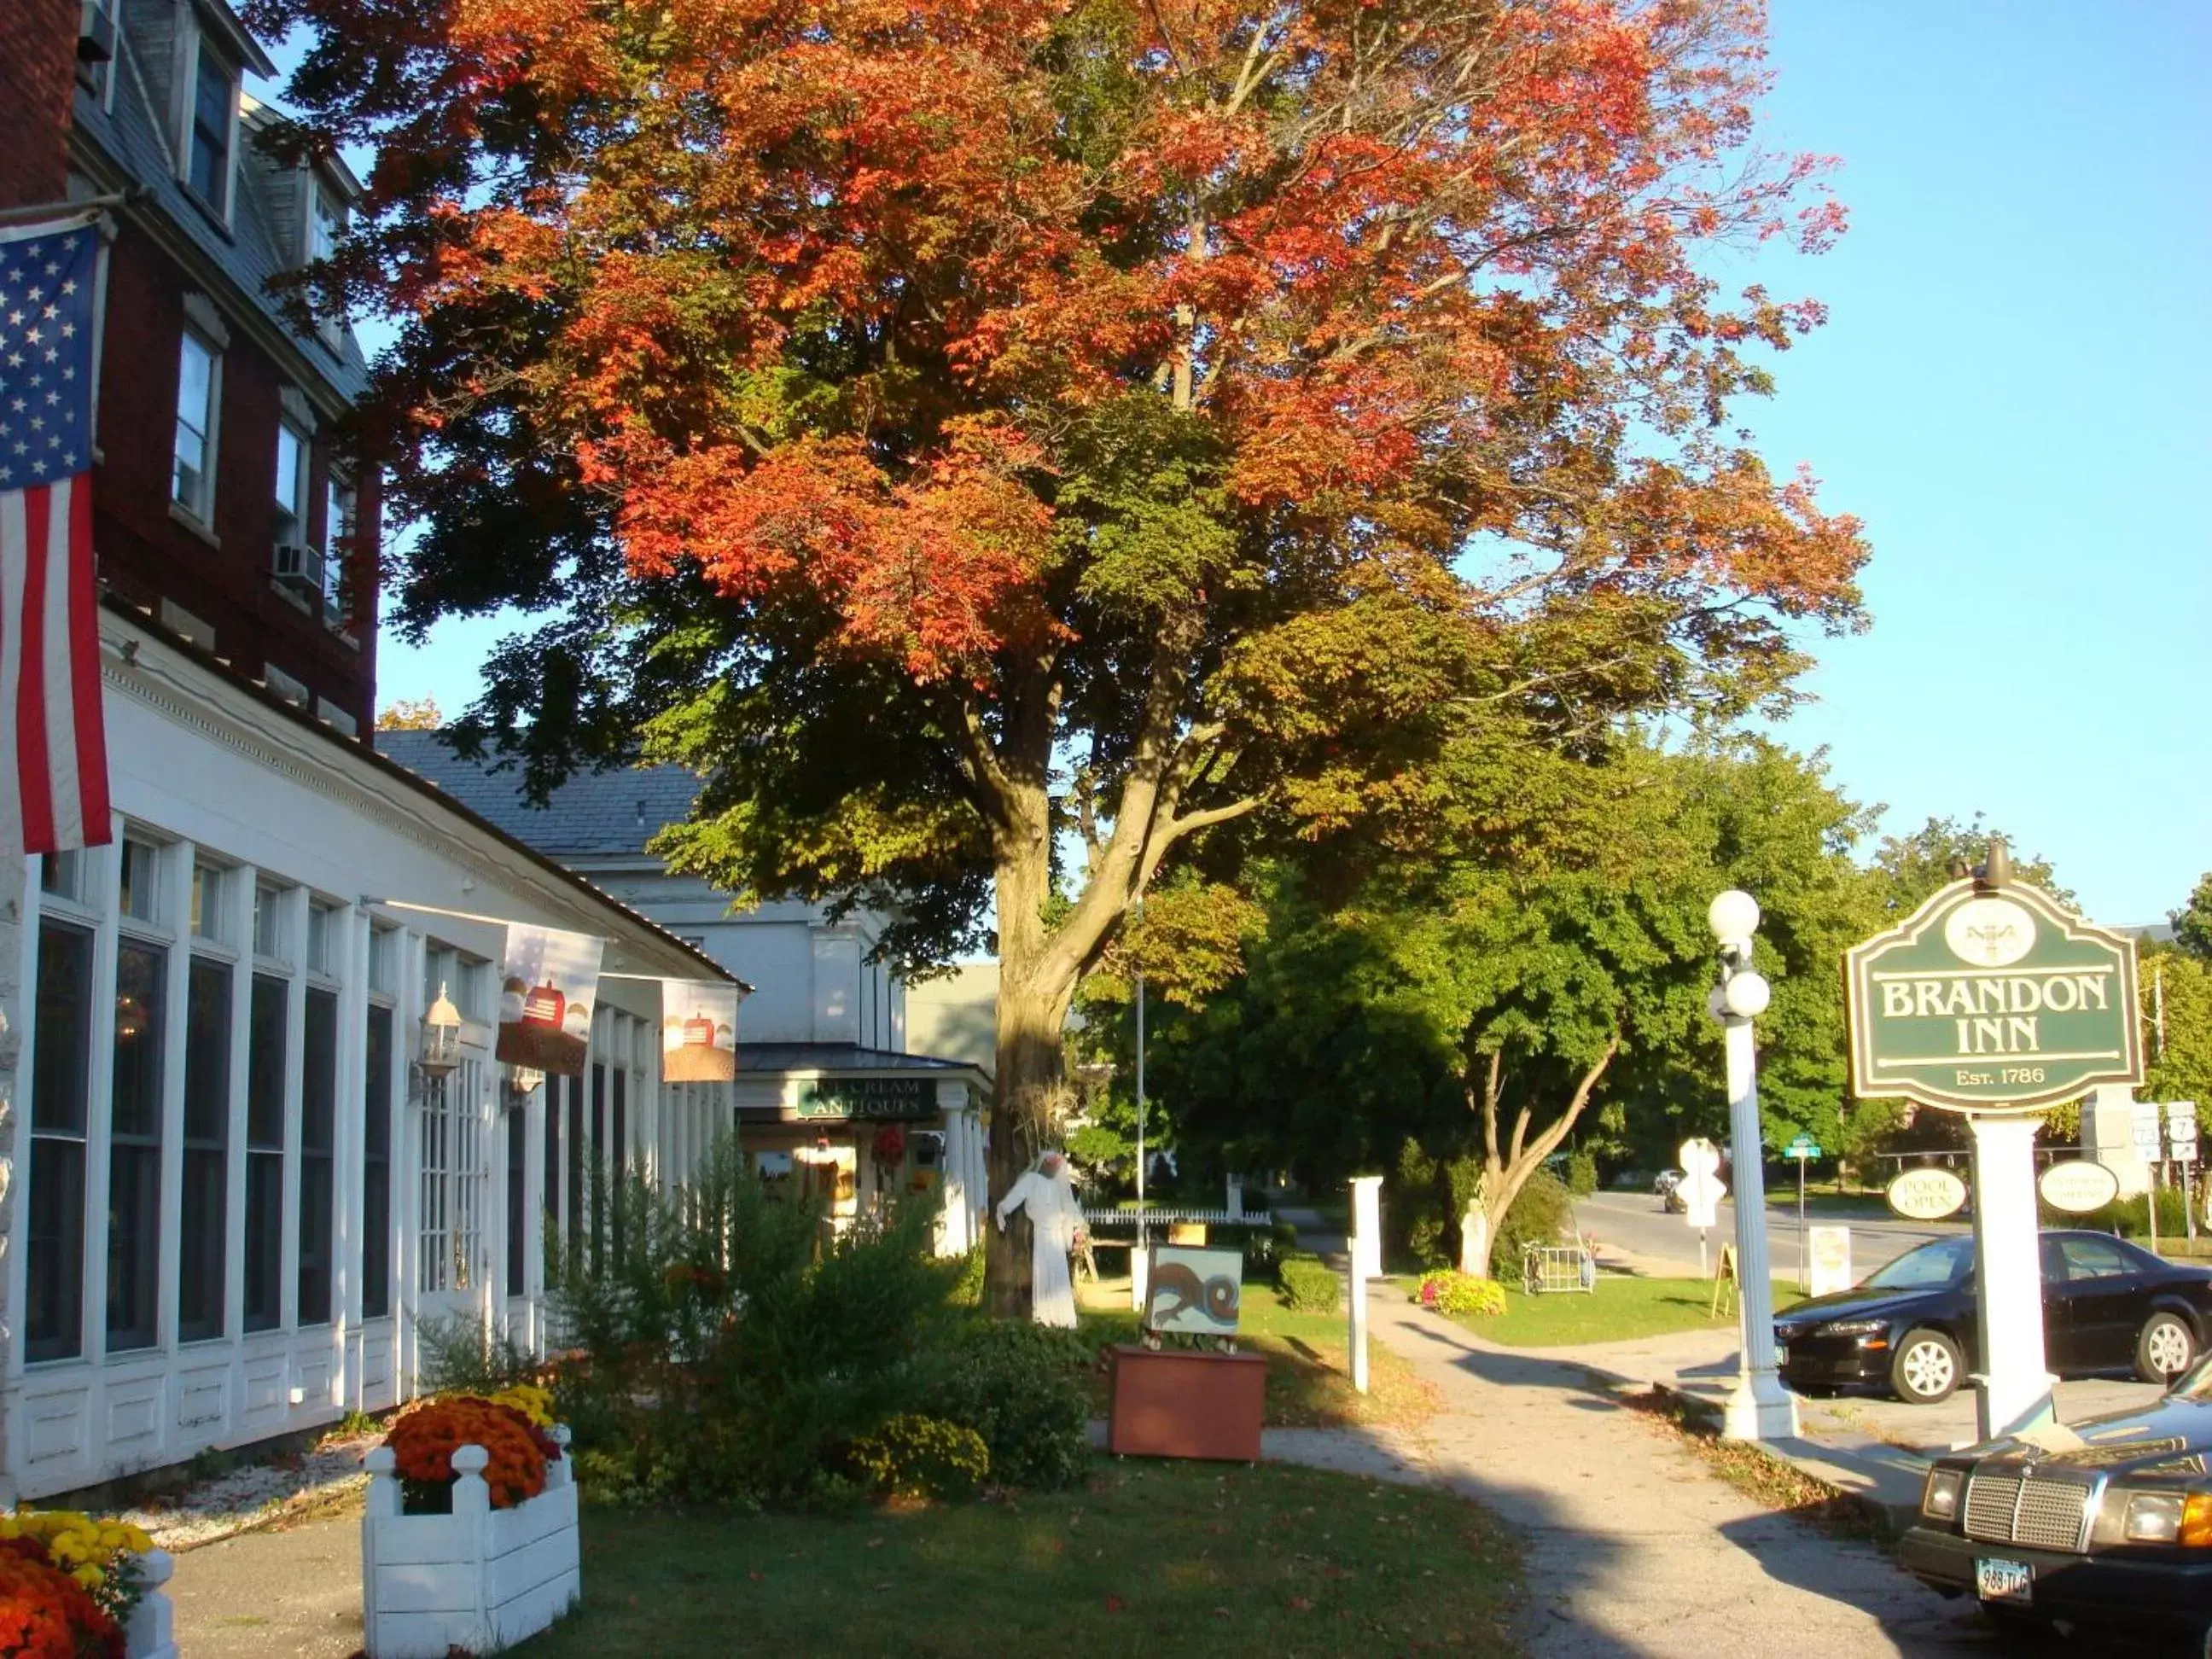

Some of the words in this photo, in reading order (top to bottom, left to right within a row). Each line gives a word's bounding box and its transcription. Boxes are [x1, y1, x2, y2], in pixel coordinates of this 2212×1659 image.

[1881, 975, 2109, 1017] BRANDON
[1956, 1016, 2040, 1053] INN
[2001, 1068, 2046, 1084] 1786
[849, 1079, 920, 1093] CREAM
[813, 1099, 921, 1115] ANTIQUES
[2178, 1121, 2186, 1135] 7
[1903, 1179, 1952, 1195] POOL
